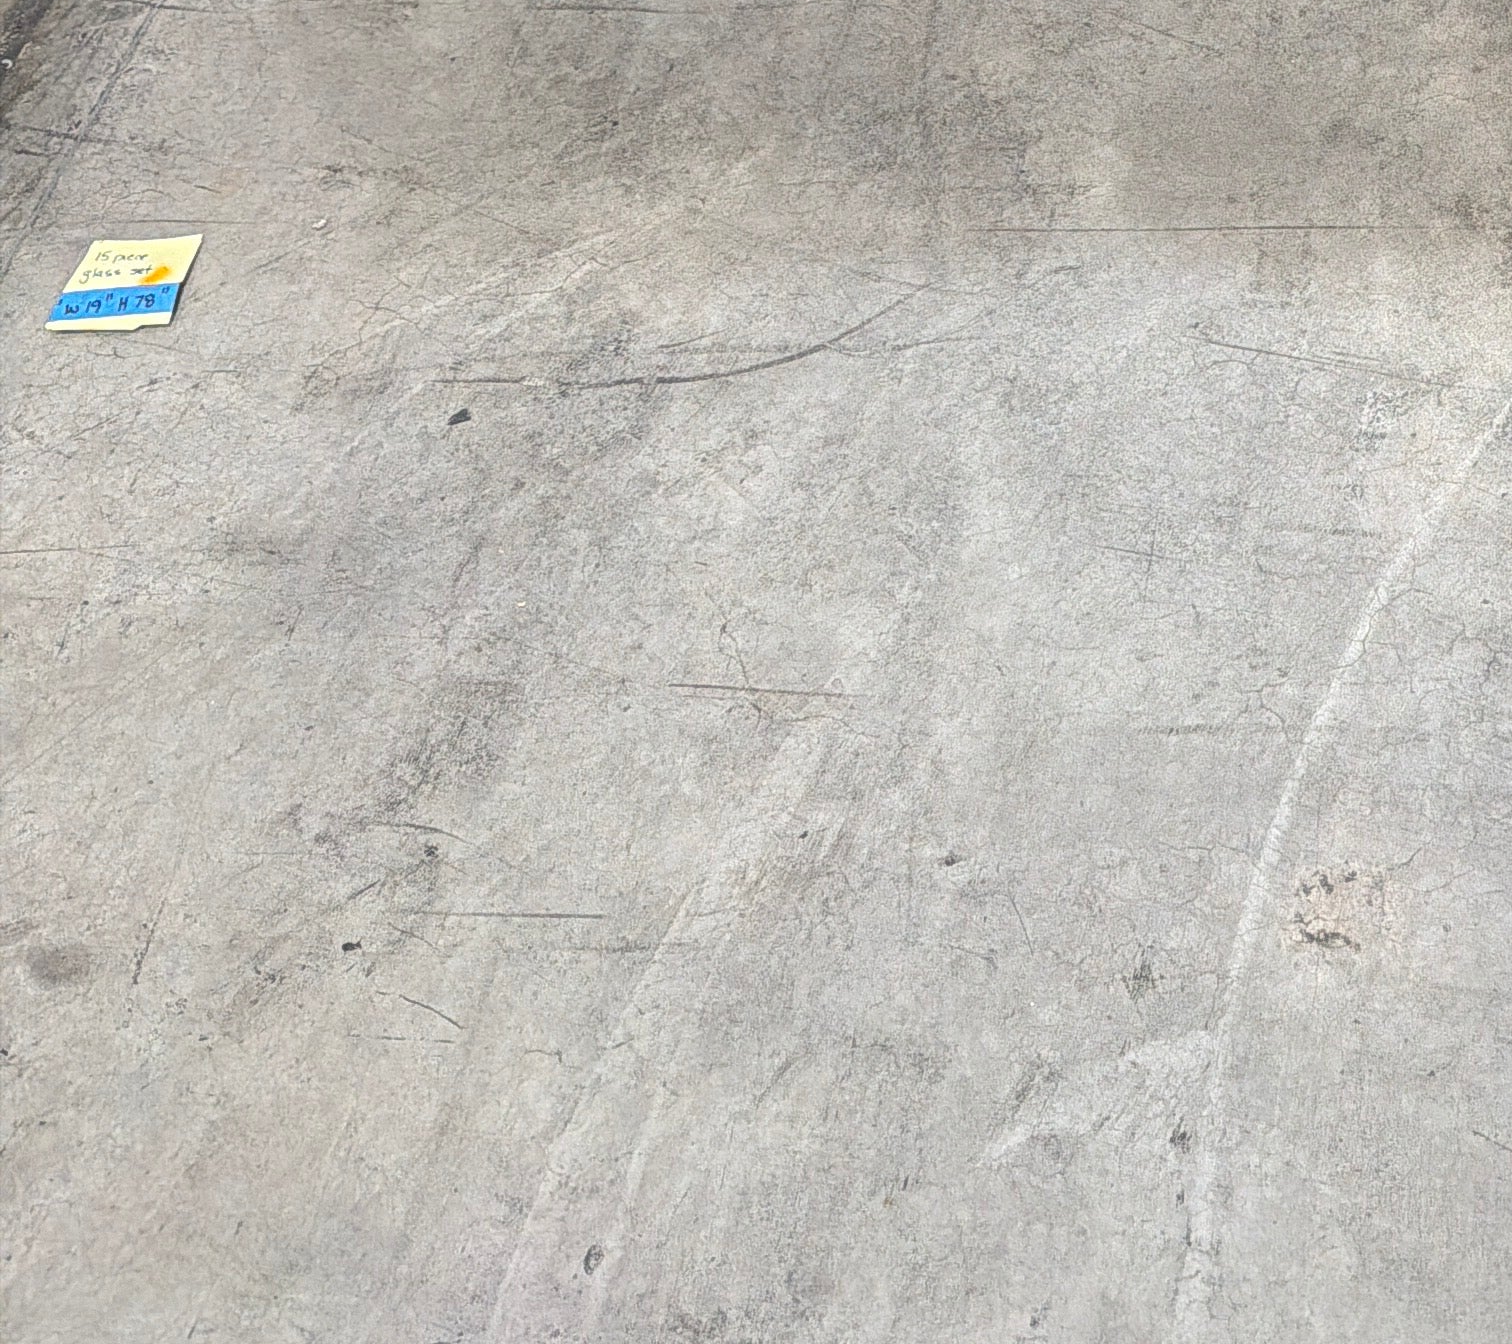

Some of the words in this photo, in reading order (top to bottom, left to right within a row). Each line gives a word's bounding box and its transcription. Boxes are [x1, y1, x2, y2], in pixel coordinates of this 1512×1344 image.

[95, 250, 110, 262] 15
[79, 267, 121, 284] glass
[130, 264, 152, 275] set
[117, 296, 129, 312] H
